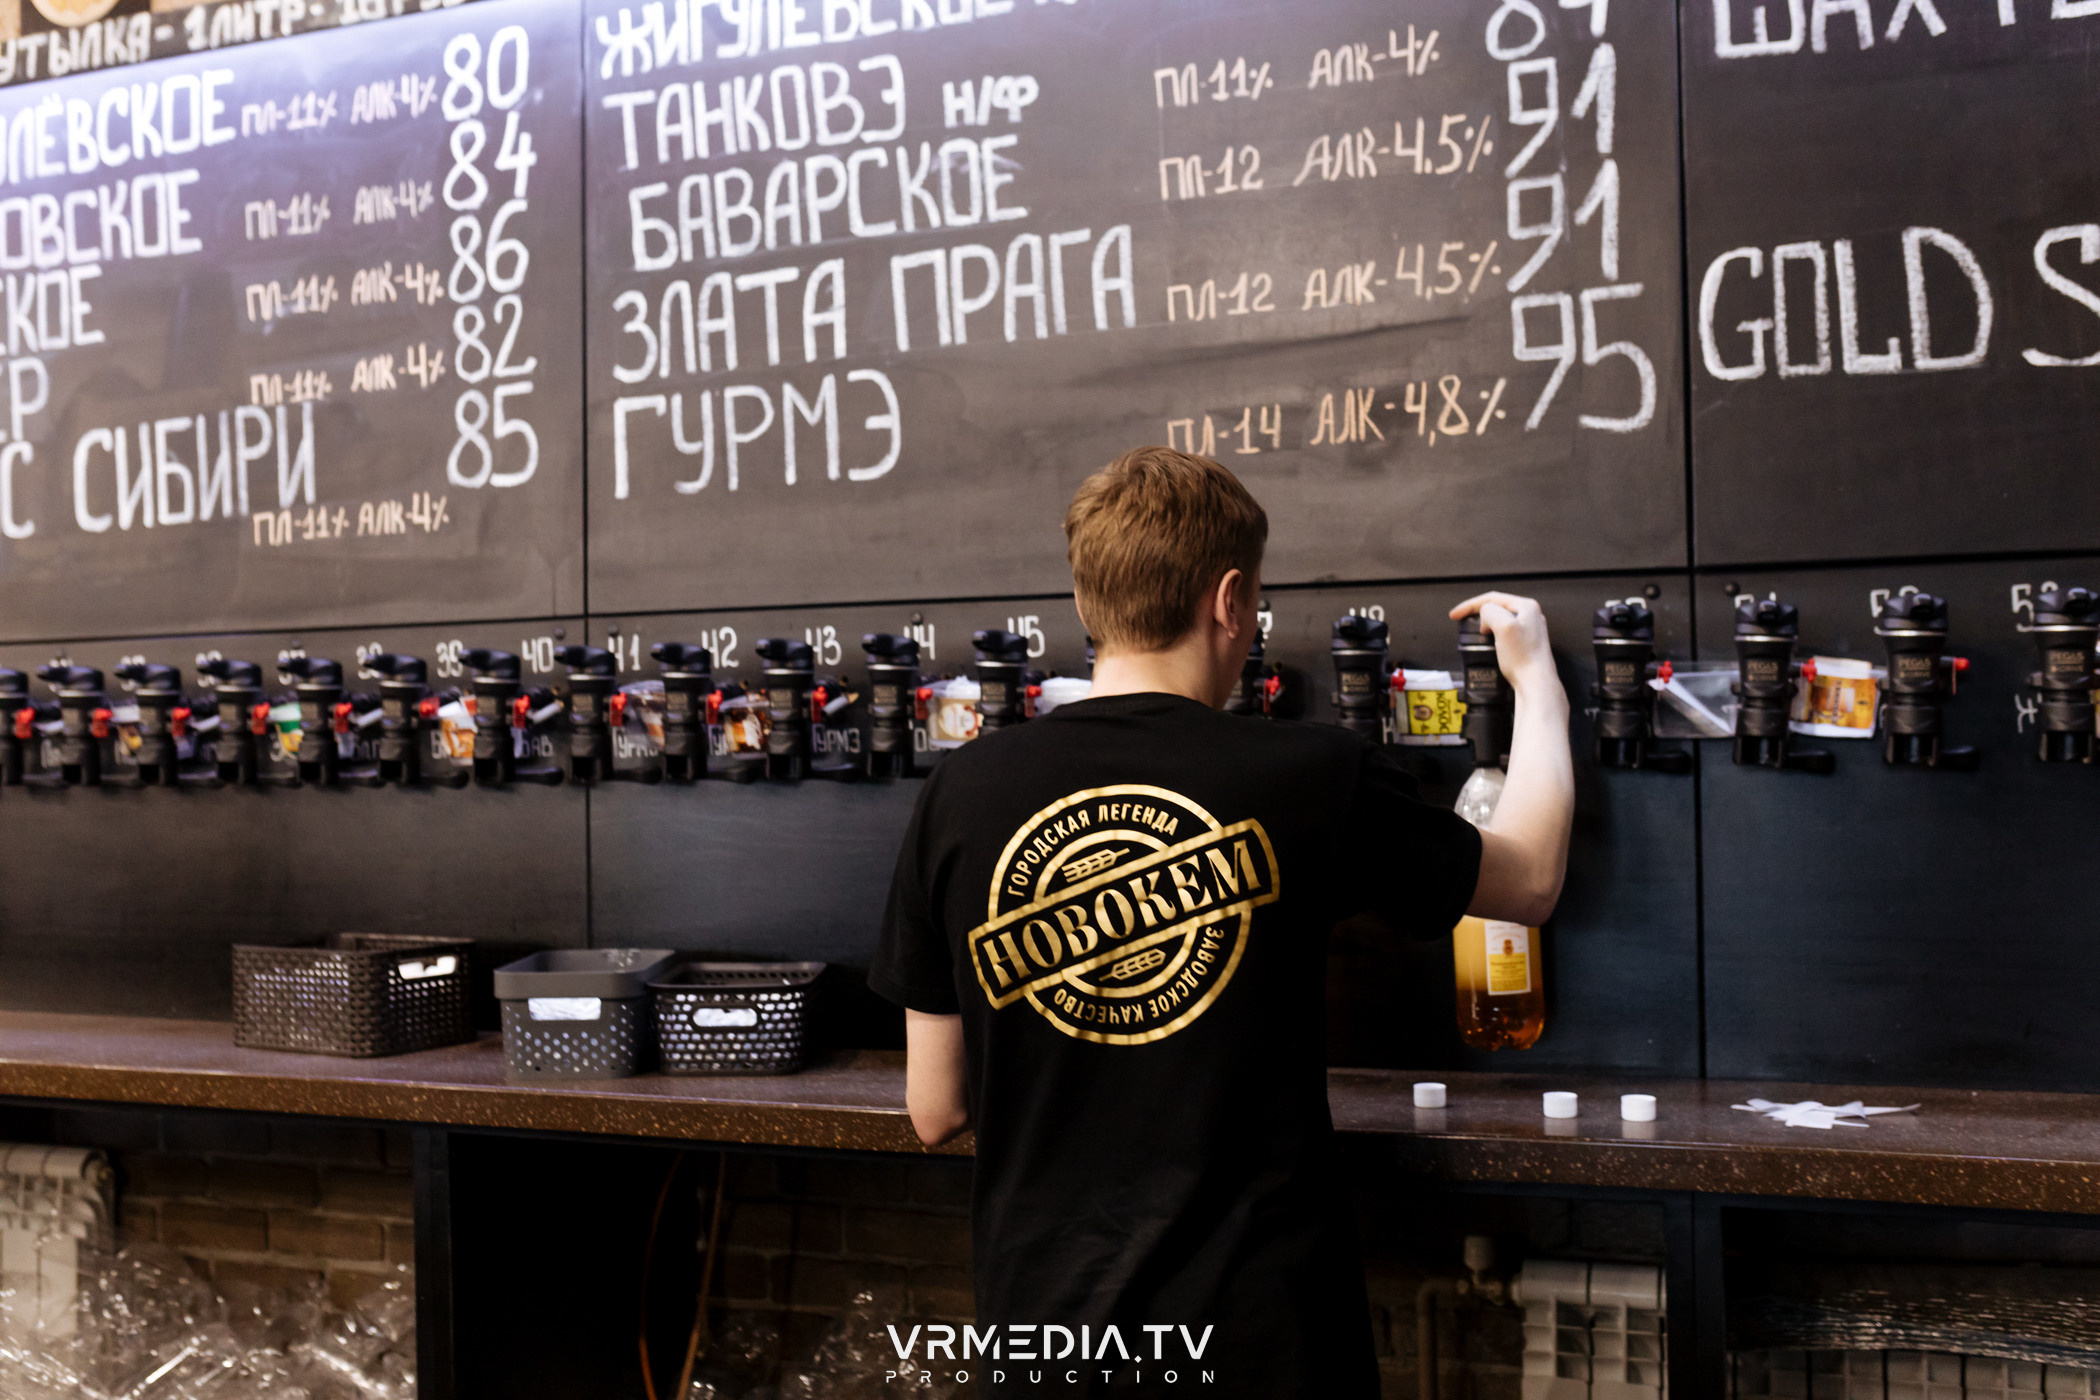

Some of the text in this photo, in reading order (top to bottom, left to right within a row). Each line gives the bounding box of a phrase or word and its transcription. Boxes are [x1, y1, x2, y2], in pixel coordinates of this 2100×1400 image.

[0, 68, 237, 187] ЛЁВСКОЕ
[441, 25, 529, 122] 80
[601, 54, 906, 170] ТАНКОВЭ
[942, 75, 1039, 128] Н/Ф
[1153, 57, 1273, 108] ПЛ-11%
[1307, 24, 1440, 89] АЛК-4%
[628, 134, 1029, 272] БАВАРСКОЕ
[1158, 145, 1264, 201] ПЛ-12
[1507, 42, 1617, 179] 91
[0, 168, 204, 270] ОВСКОЕ
[443, 110, 538, 211] 84
[0, 262, 106, 356] КОЕ
[448, 198, 530, 304] 86
[453, 294, 538, 384] 82
[612, 258, 847, 384] ЗЛАТА
[890, 224, 1138, 353] ПРАГА
[1166, 272, 1276, 322] ПЛ-12
[1507, 157, 1620, 293] 91
[1698, 226, 1994, 381] GOLD
[446, 380, 540, 489] 85
[613, 368, 902, 500] ГУРМЭ
[1167, 402, 1282, 458] ПЛ-14
[1511, 282, 1657, 432] 95
[520, 635, 557, 674] 40
[607, 632, 642, 673] 41
[701, 625, 739, 669] 42
[805, 624, 842, 667] 43
[981, 838, 1263, 990] НОВОКЕМ
[1007, 802, 1179, 898] ГОРОДСКАЯ ЛЕГЕНДА
[1053, 926, 1225, 1025] ЗАВОДСКОЕ КАЧЕСТВО
